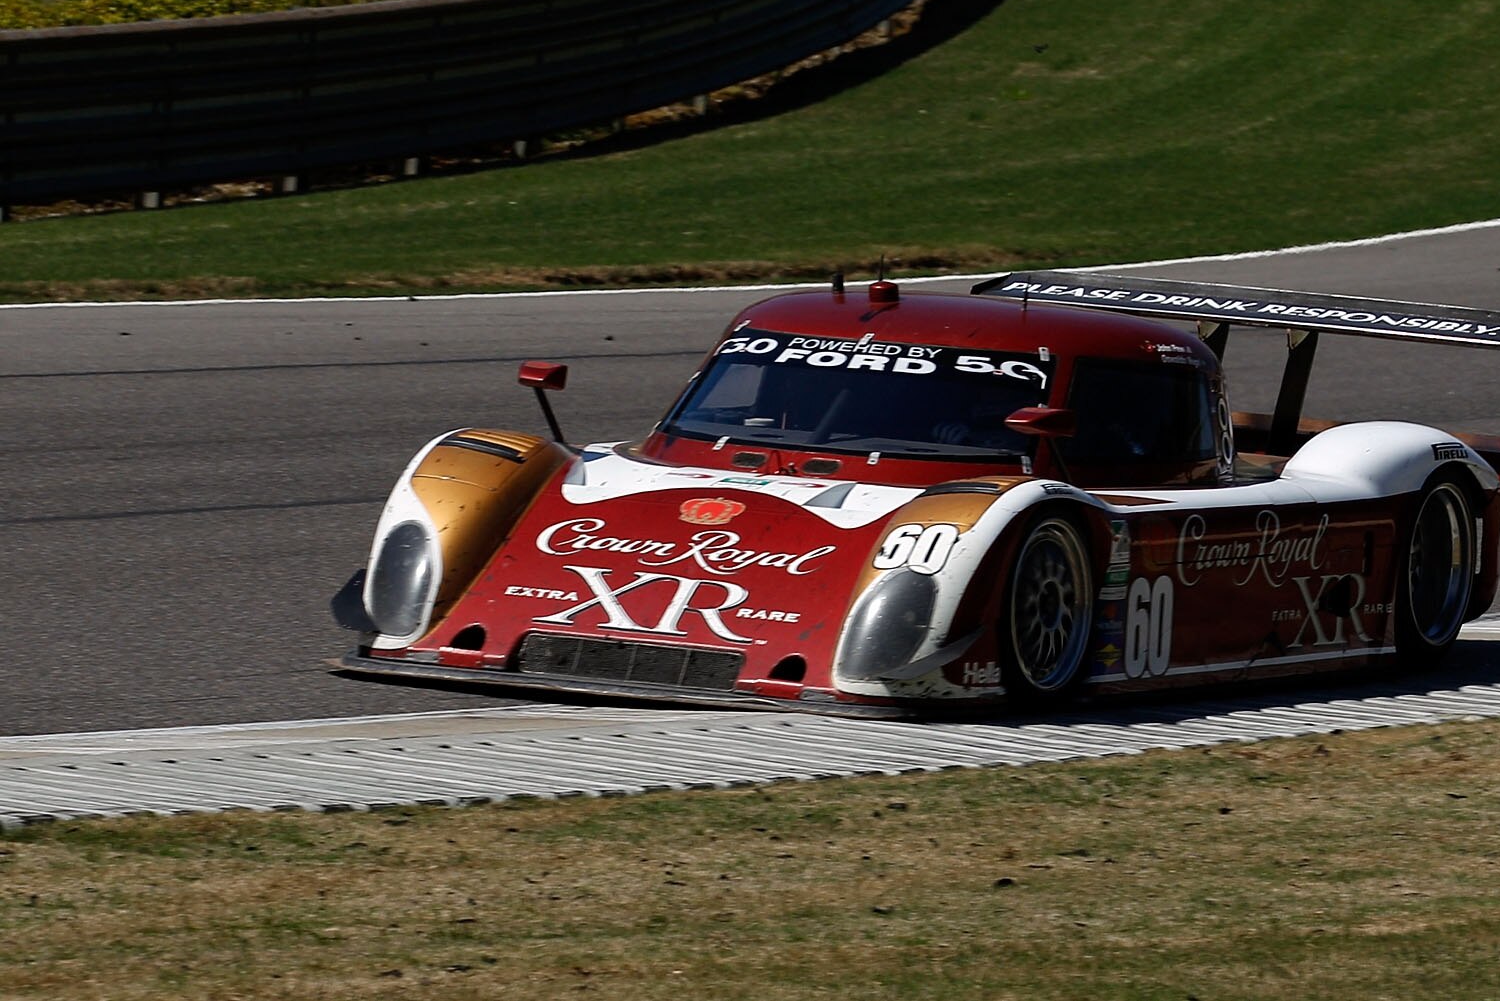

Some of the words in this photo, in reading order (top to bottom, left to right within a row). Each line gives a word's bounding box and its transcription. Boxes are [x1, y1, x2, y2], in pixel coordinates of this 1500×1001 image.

[1001, 281, 1131, 302] PLEASE
[1131, 292, 1258, 313] DRINK
[1257, 302, 1500, 336] RESPONSIBLY.
[788, 336, 902, 356] POWERED
[908, 346, 943, 359] BY
[774, 348, 938, 375] FORD
[1431, 442, 1469, 461] PIRELLI
[535, 517, 676, 556] Crown
[637, 530, 837, 576] Royal
[872, 522, 961, 576] 60
[1176, 514, 1250, 587] Crown
[1233, 509, 1329, 588] Royal
[503, 585, 580, 602] EXTRA
[531, 564, 753, 643] XR
[735, 606, 801, 624] RARE
[1363, 602, 1394, 615] RARE
[1123, 574, 1175, 679] 60
[962, 661, 1001, 685] Hella
